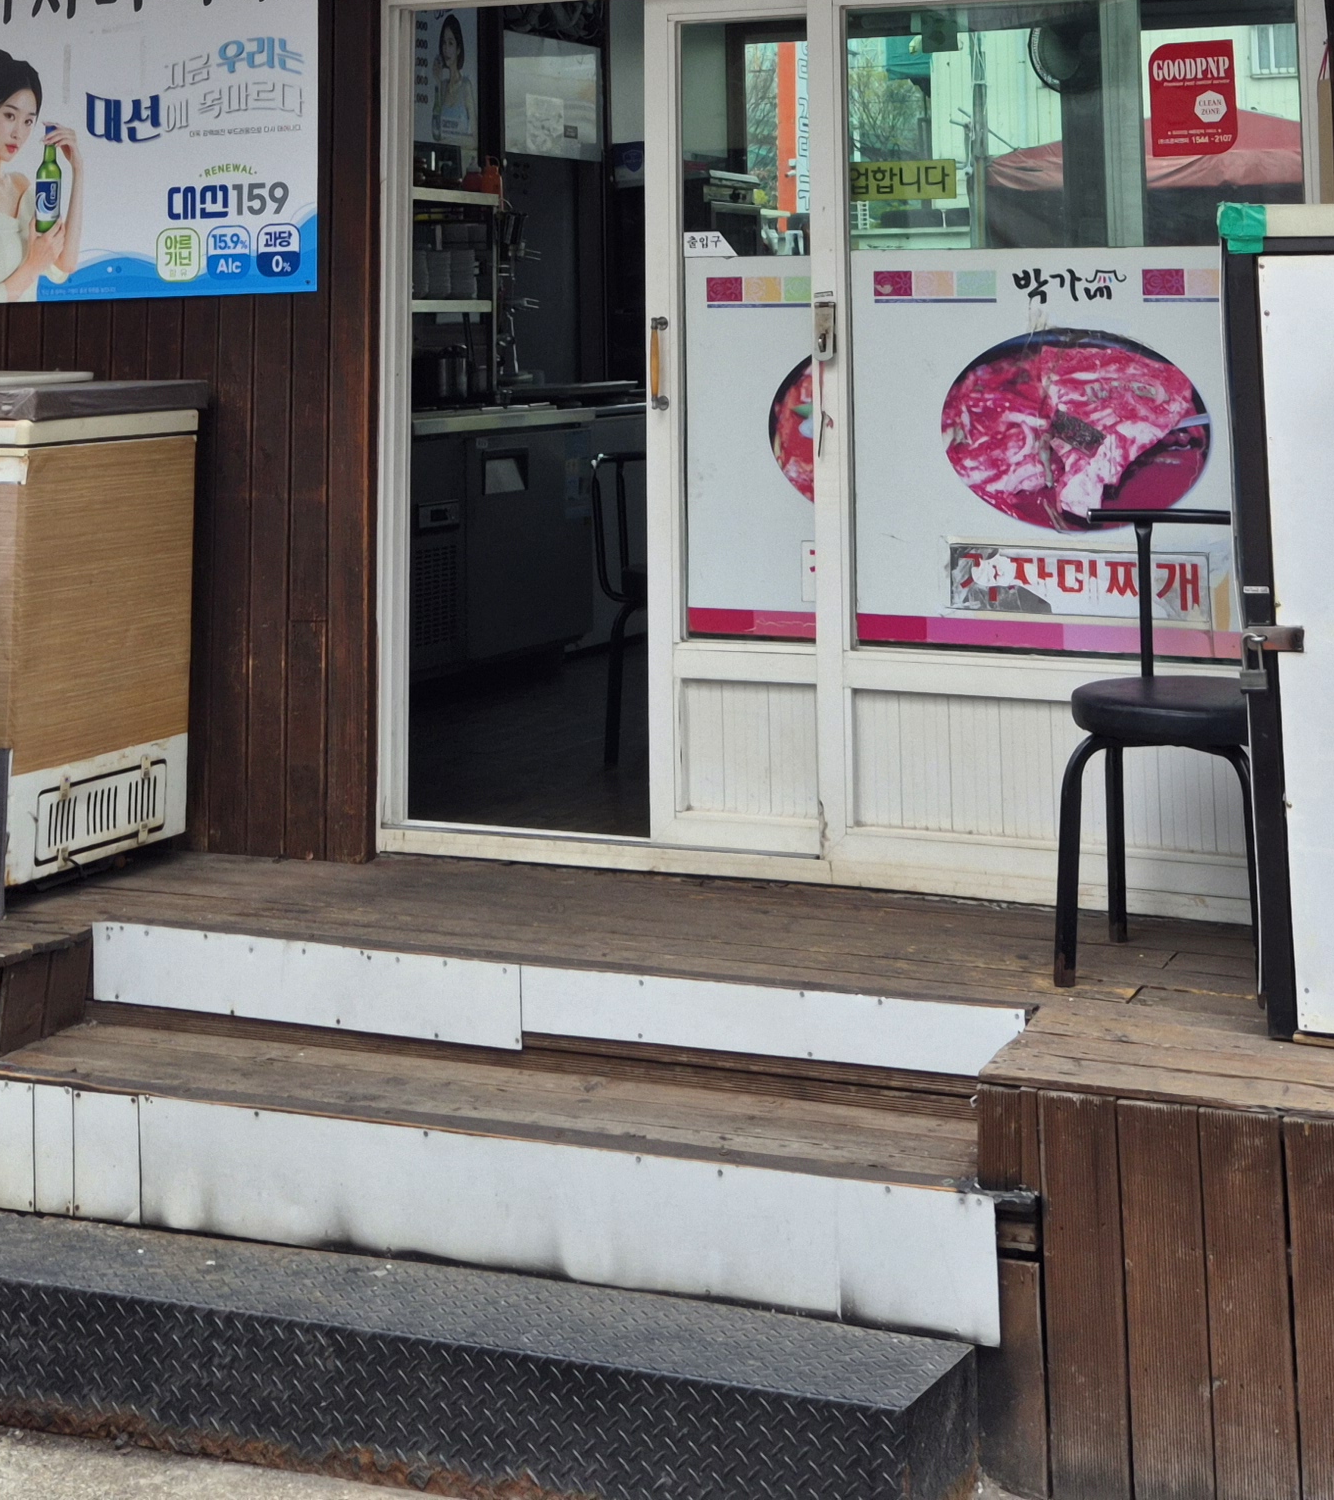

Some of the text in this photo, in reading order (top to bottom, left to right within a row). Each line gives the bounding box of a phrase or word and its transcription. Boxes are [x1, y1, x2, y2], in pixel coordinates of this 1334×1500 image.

[164, 37, 304, 92] 지금 우리는
[1152, 56, 1230, 81] GOODPNP
[198, 82, 305, 119] 목마르다
[1198, 98, 1222, 107] CLEAN
[1201, 107, 1221, 116] ZONE
[203, 163, 254, 178] RENEWAL
[165, 234, 192, 250] 아르
[211, 233, 248, 251] 15.9%
[263, 231, 293, 248] 과당
[687, 234, 723, 249] 출입구
[165, 251, 192, 267] 기닌
[216, 258, 242, 274] Alc
[271, 255, 291, 273] 0%
